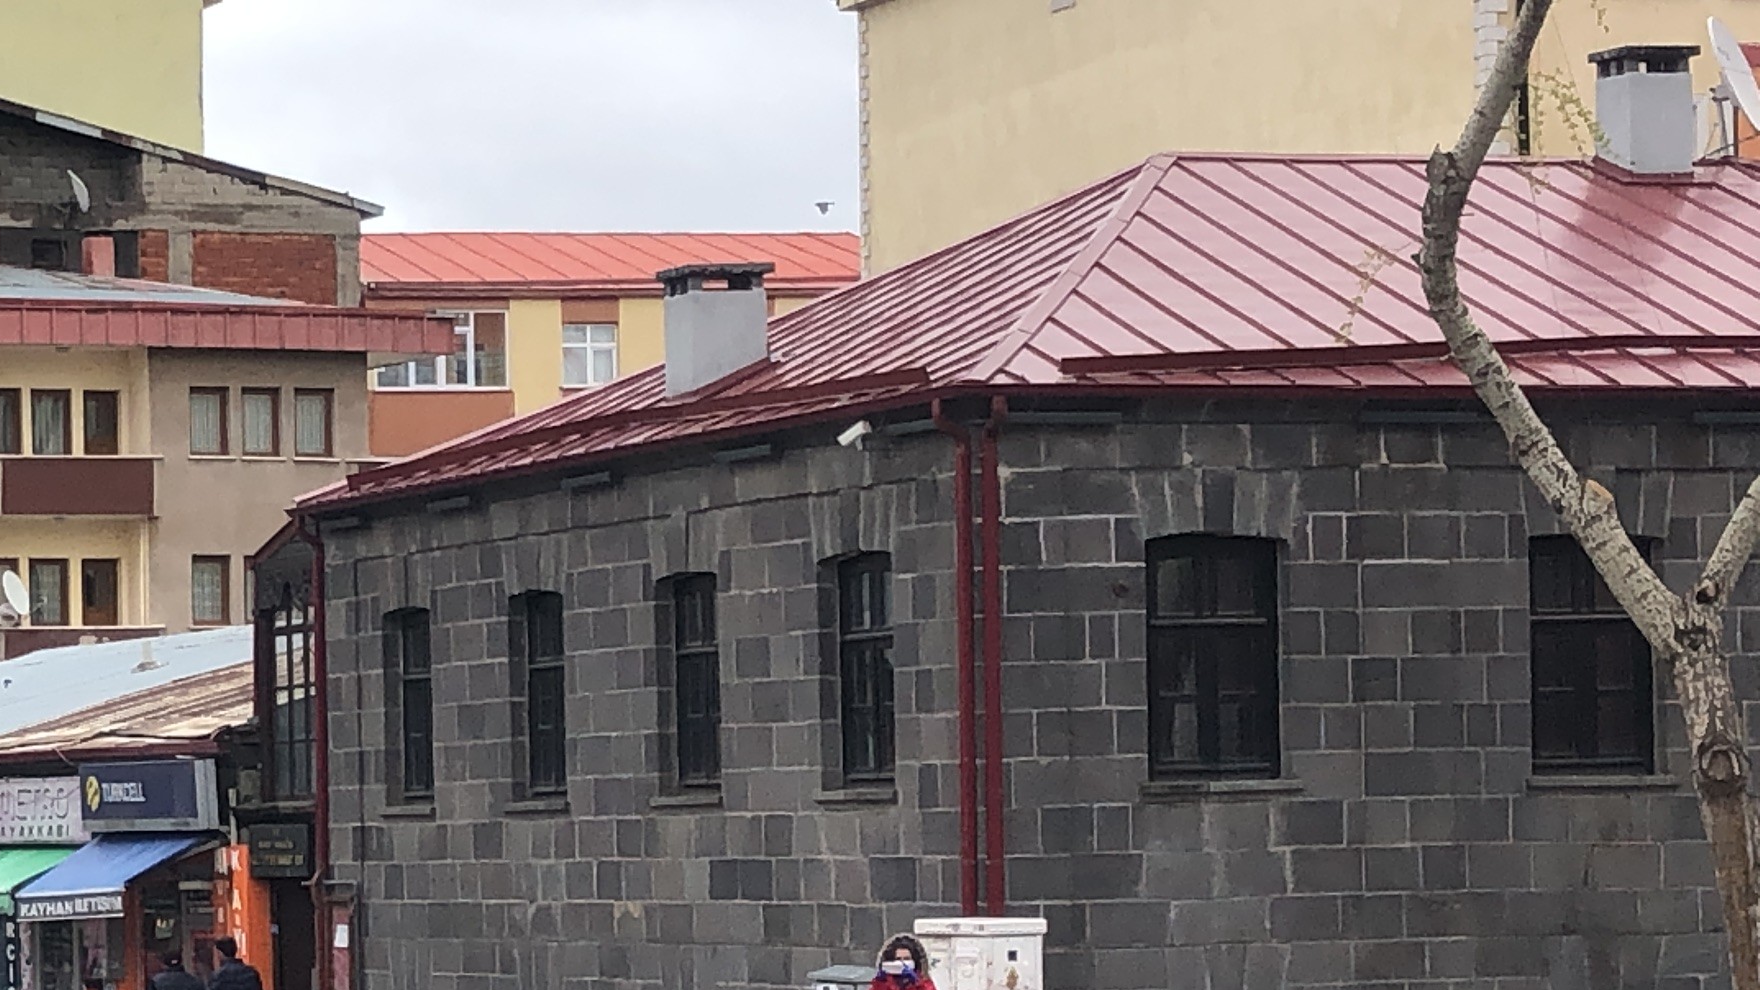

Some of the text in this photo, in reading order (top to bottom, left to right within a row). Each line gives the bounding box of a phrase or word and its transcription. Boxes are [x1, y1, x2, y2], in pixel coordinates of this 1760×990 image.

[101, 782, 147, 802] TURKCELL
[0, 824, 71, 838] AYAKKABI
[20, 901, 74, 917] KAYHAN
